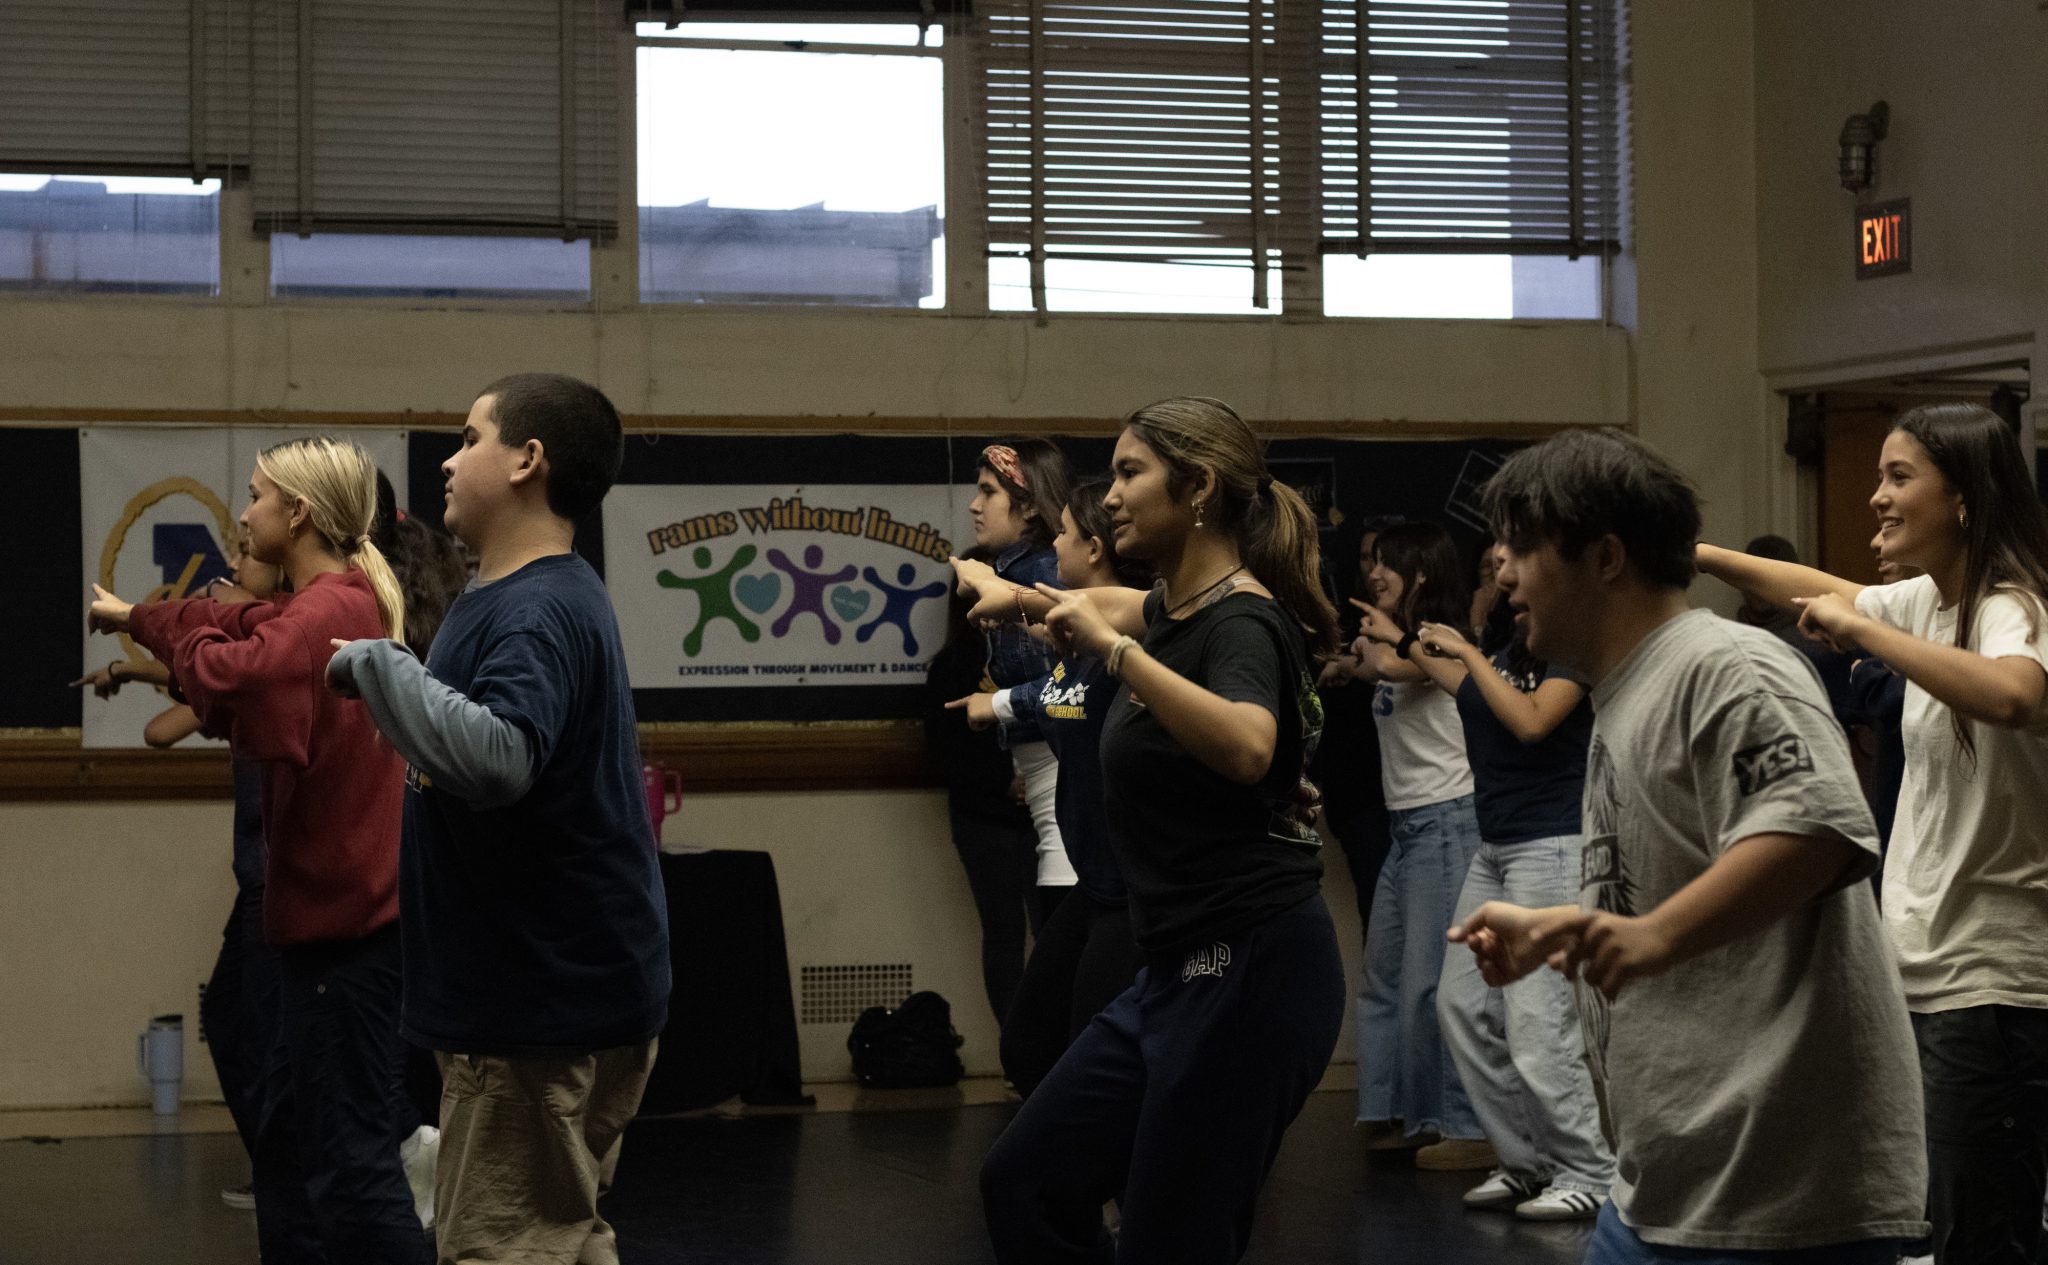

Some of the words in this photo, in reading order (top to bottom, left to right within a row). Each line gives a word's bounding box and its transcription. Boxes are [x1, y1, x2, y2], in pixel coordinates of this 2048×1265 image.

[1862, 214, 1901, 265] EXIT
[647, 511, 738, 555] rams
[864, 506, 953, 563] limits
[678, 665, 749, 676] EXPRESSION
[753, 664, 805, 675] THROUGH
[809, 663, 876, 674] MOVEMENT
[880, 662, 888, 673] &
[891, 662, 929, 673] DANCE
[1735, 738, 1810, 794] YES!
[1181, 940, 1231, 983] GAP
